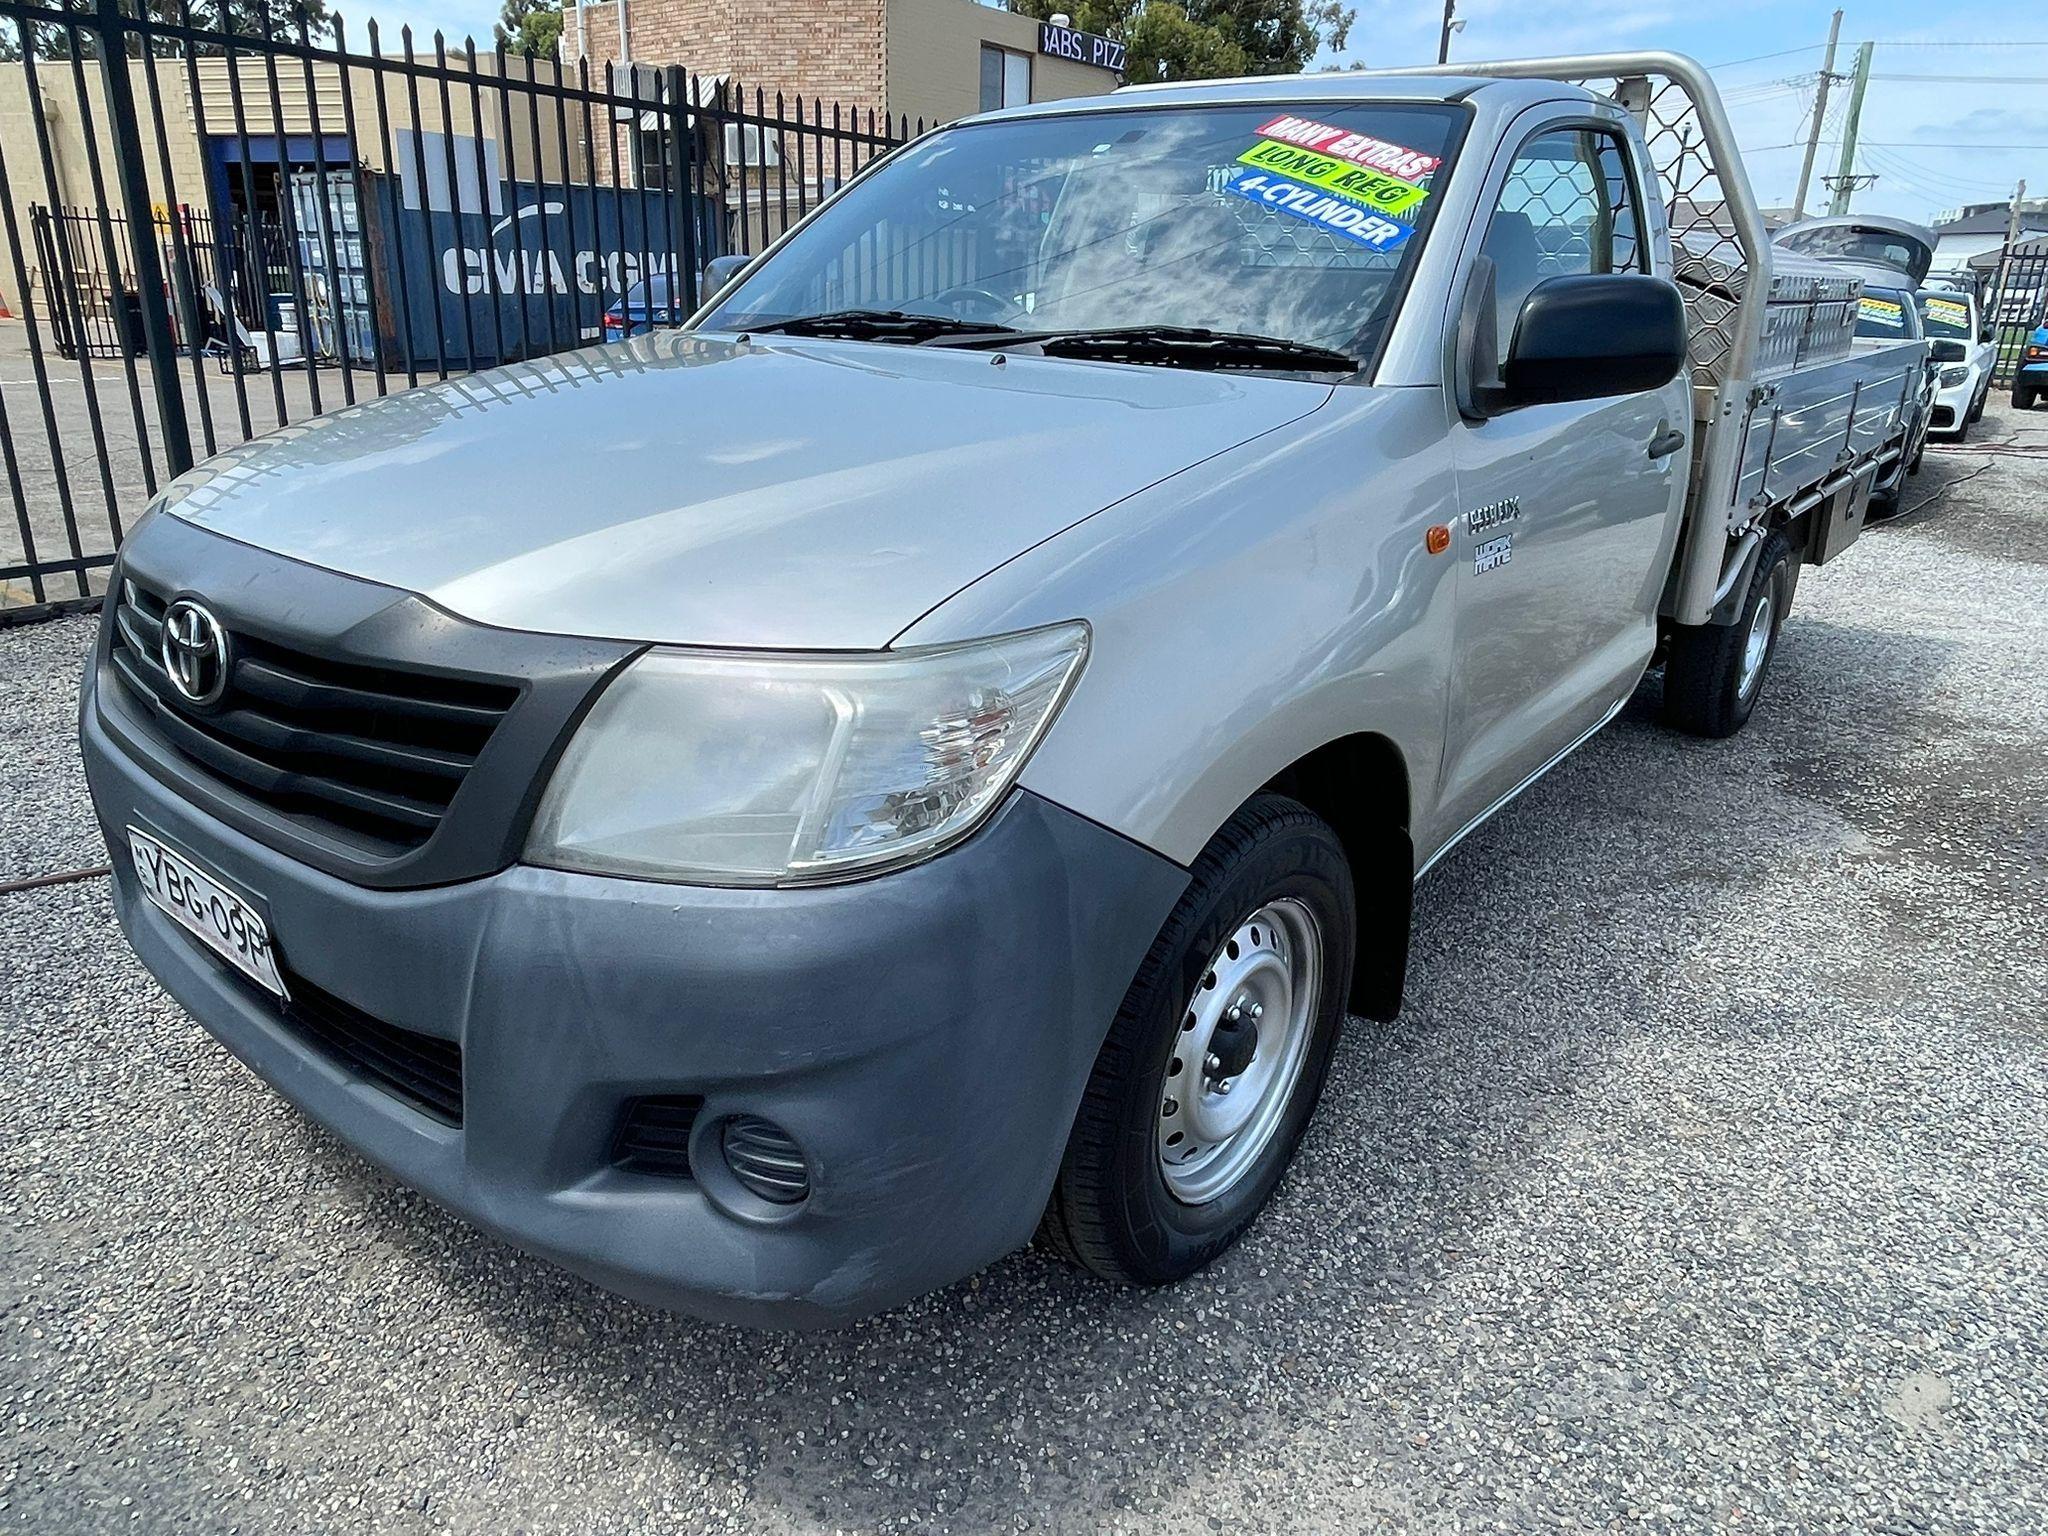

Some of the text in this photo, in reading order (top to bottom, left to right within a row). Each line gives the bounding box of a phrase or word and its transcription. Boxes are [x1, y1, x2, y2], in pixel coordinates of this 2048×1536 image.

[1263, 116, 1432, 175] MANY EXTRAS
[1252, 145, 1410, 204] LONG REG
[1239, 175, 1400, 246] 4-CYLINDER
[442, 247, 568, 295] CMA
[1474, 534, 1512, 560] WORK
[1474, 549, 1512, 575] MATE
